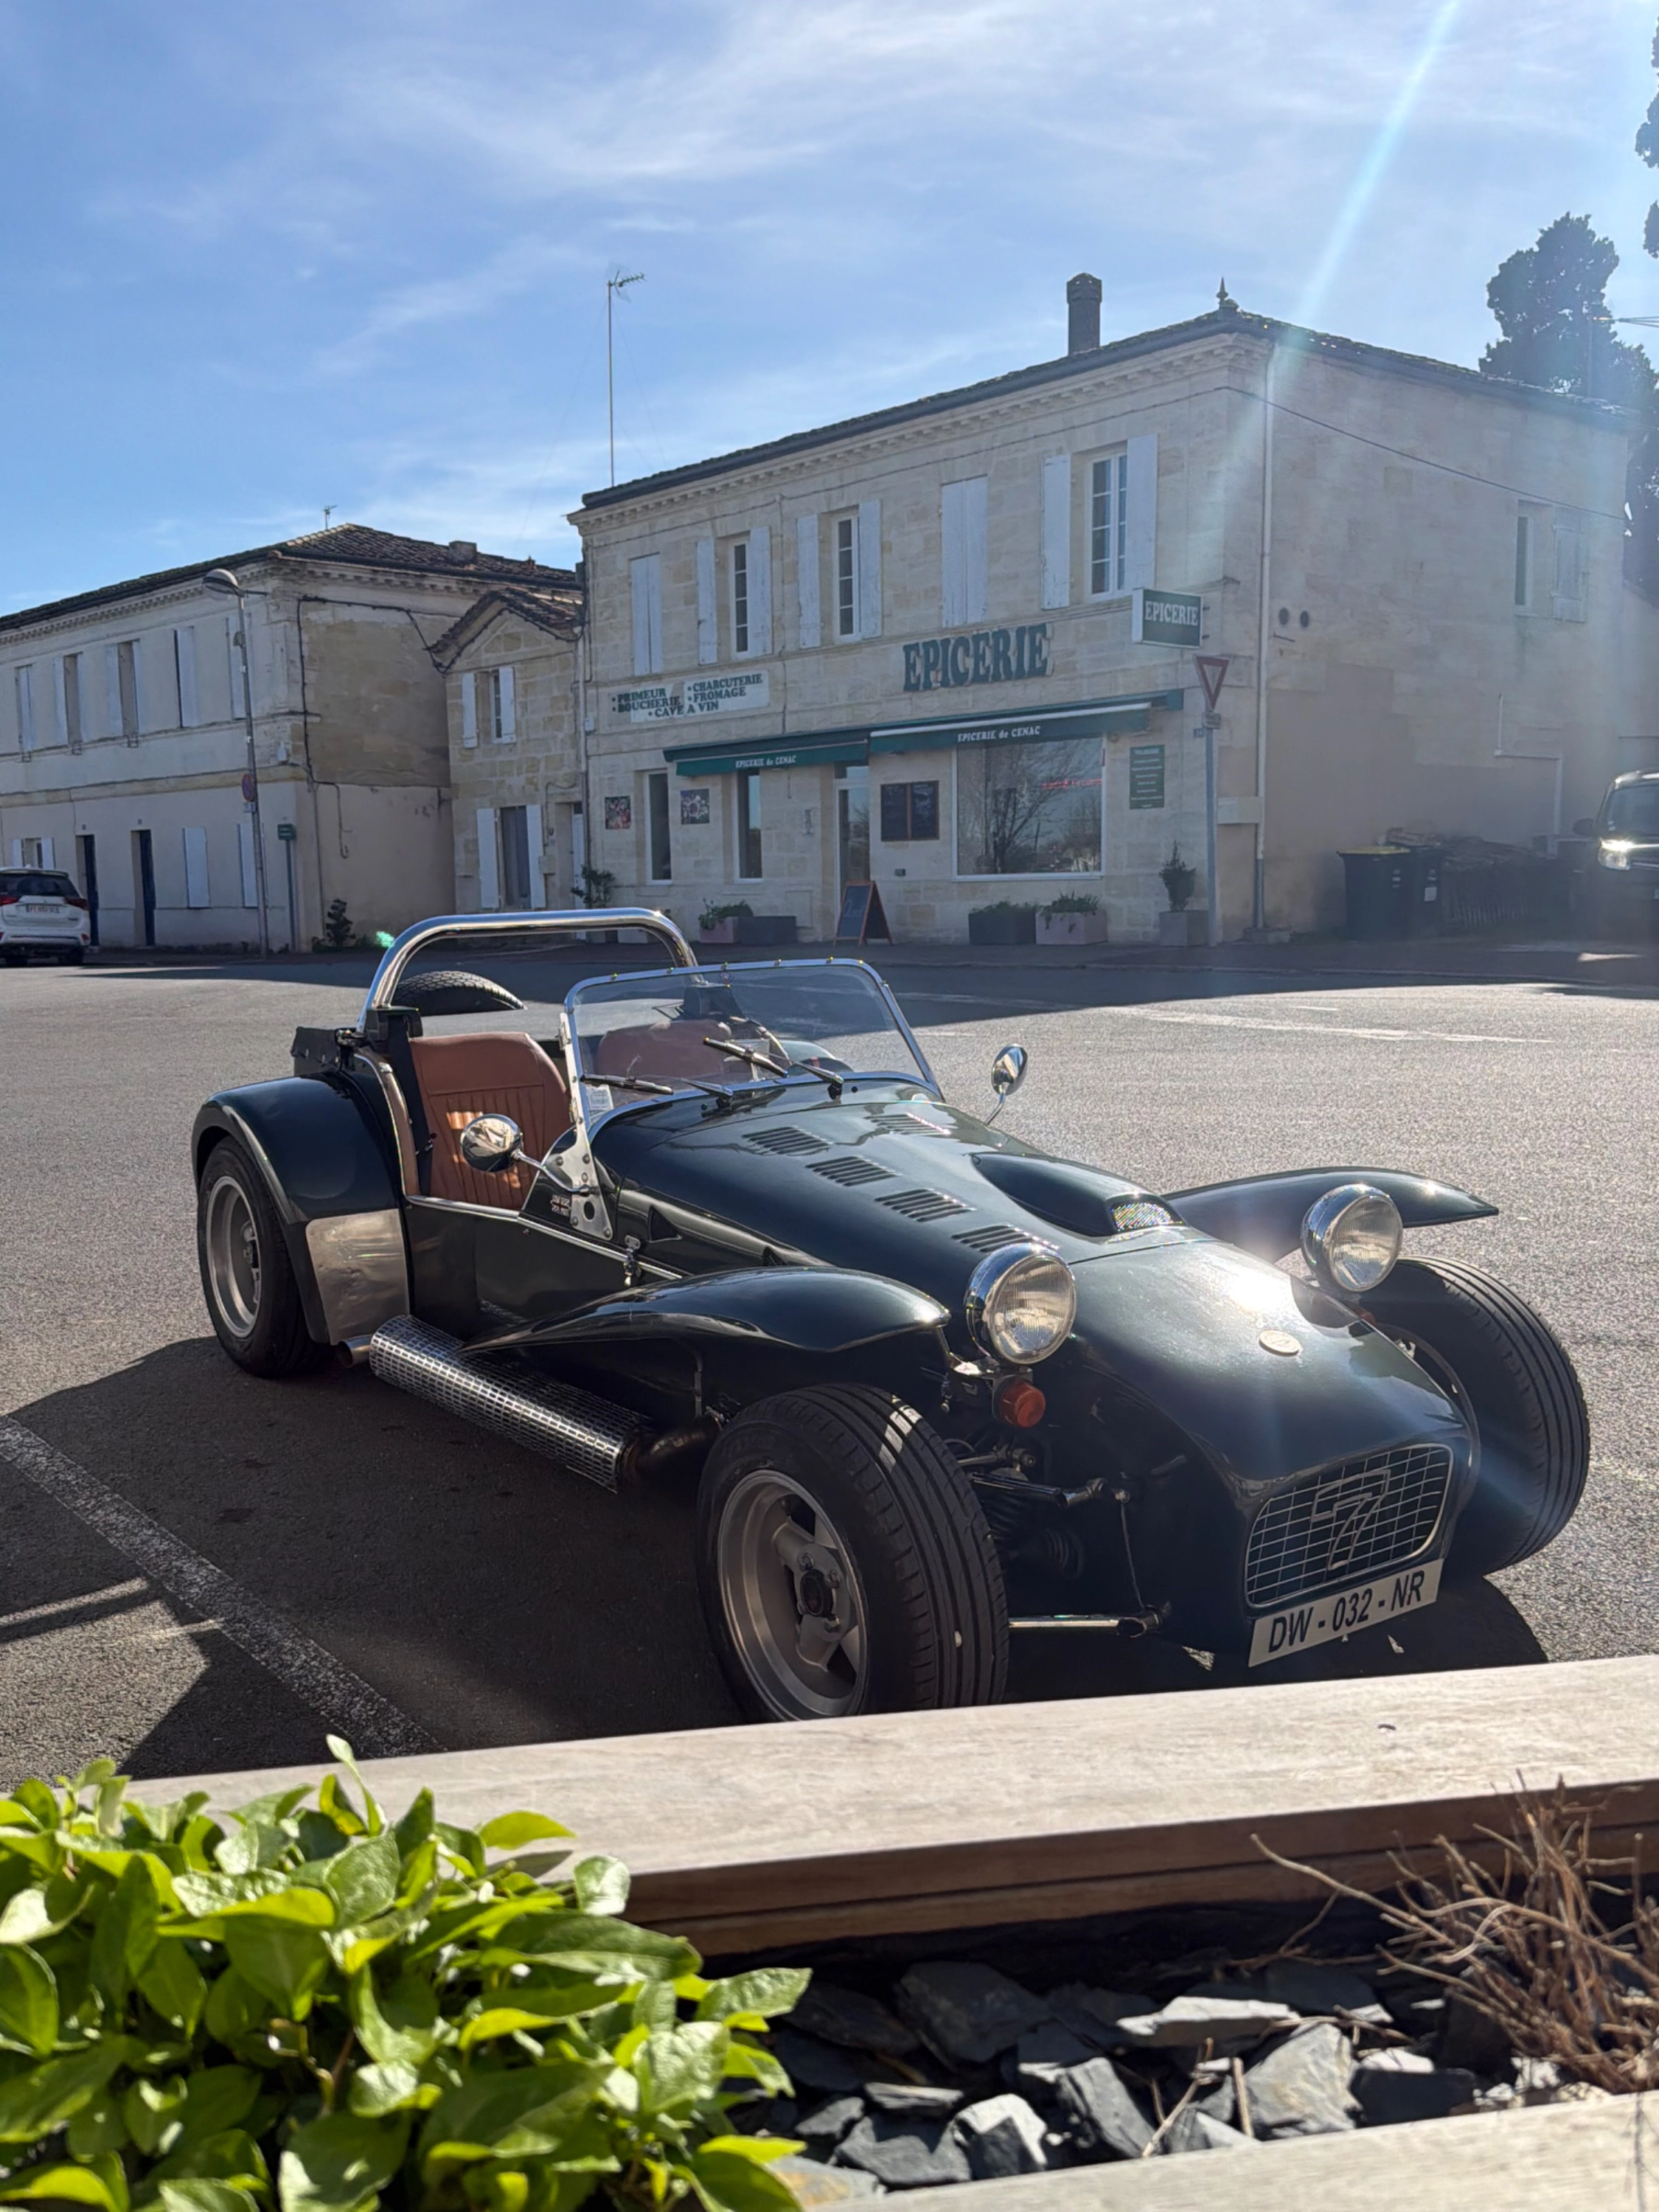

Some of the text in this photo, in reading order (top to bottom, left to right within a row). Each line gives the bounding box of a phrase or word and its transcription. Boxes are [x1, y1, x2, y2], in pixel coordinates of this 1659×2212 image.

[1145, 601, 1199, 626] EPICERIE
[903, 623, 1048, 692] EPICERIE
[692, 673, 762, 692] CHARCUTERIE
[617, 688, 667, 700] PRIMEUR
[694, 686, 746, 703] FROMAGE
[618, 696, 681, 712] BOUCHERIE
[654, 700, 719, 717] CAVE A VIN
[958, 726, 1041, 742] EPICERIE de CENAC
[1310, 1470, 1391, 1571] 7
